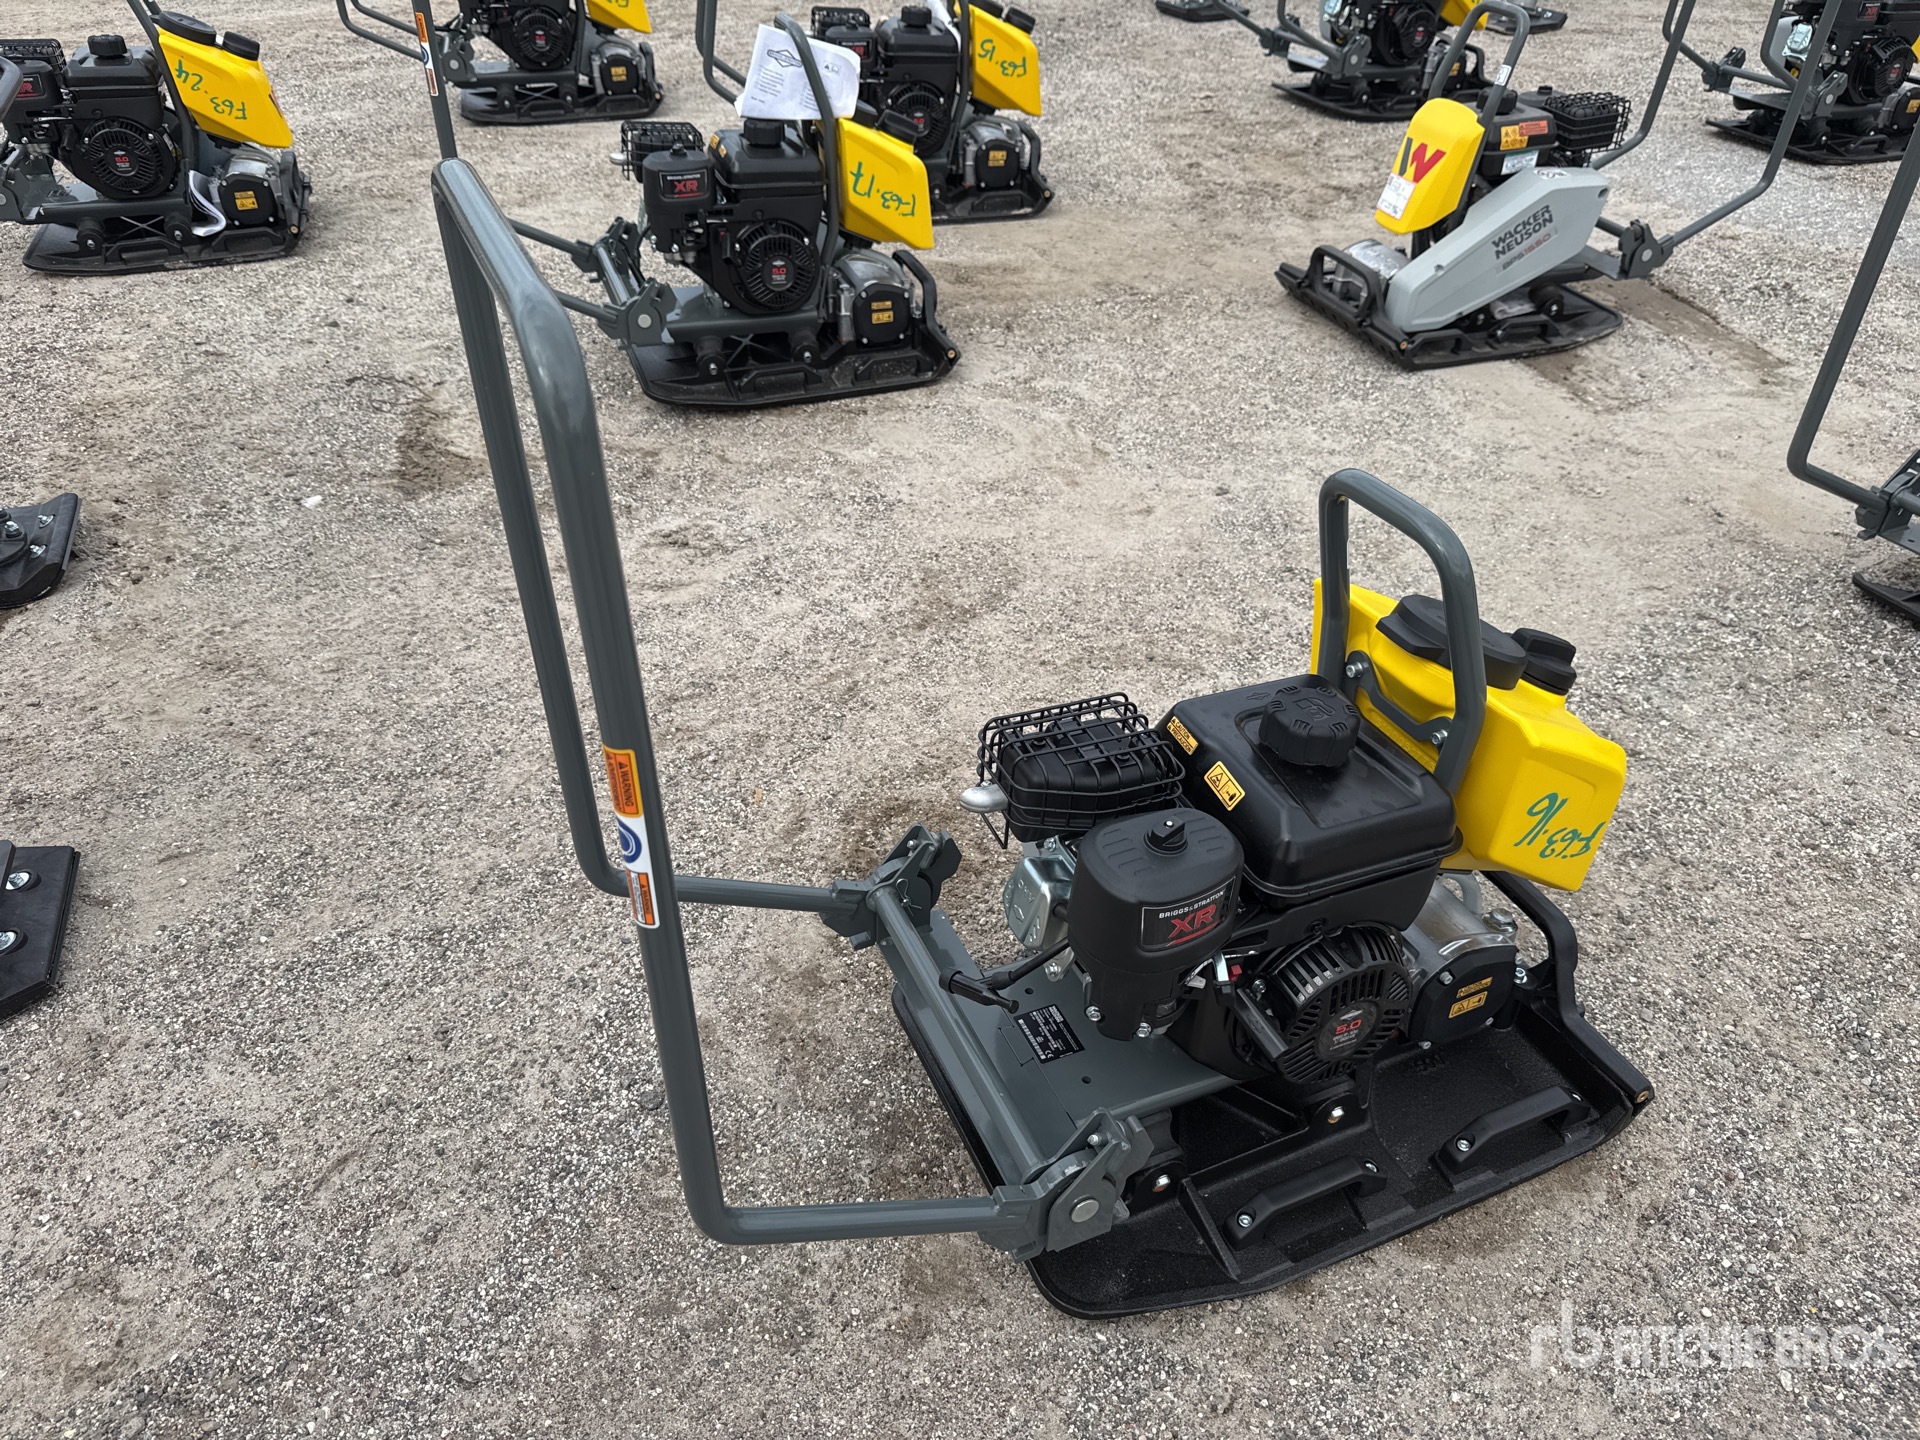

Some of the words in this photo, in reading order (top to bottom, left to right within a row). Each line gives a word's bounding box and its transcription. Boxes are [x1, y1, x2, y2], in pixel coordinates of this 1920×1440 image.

[673, 180, 699, 193] XR
[1491, 204, 1551, 249] WACKER
[1495, 213, 1554, 260] NEUSON
[619, 769, 635, 808] WARNING
[1168, 903, 1217, 939] XR
[1335, 1019, 1362, 1035] 5.0
